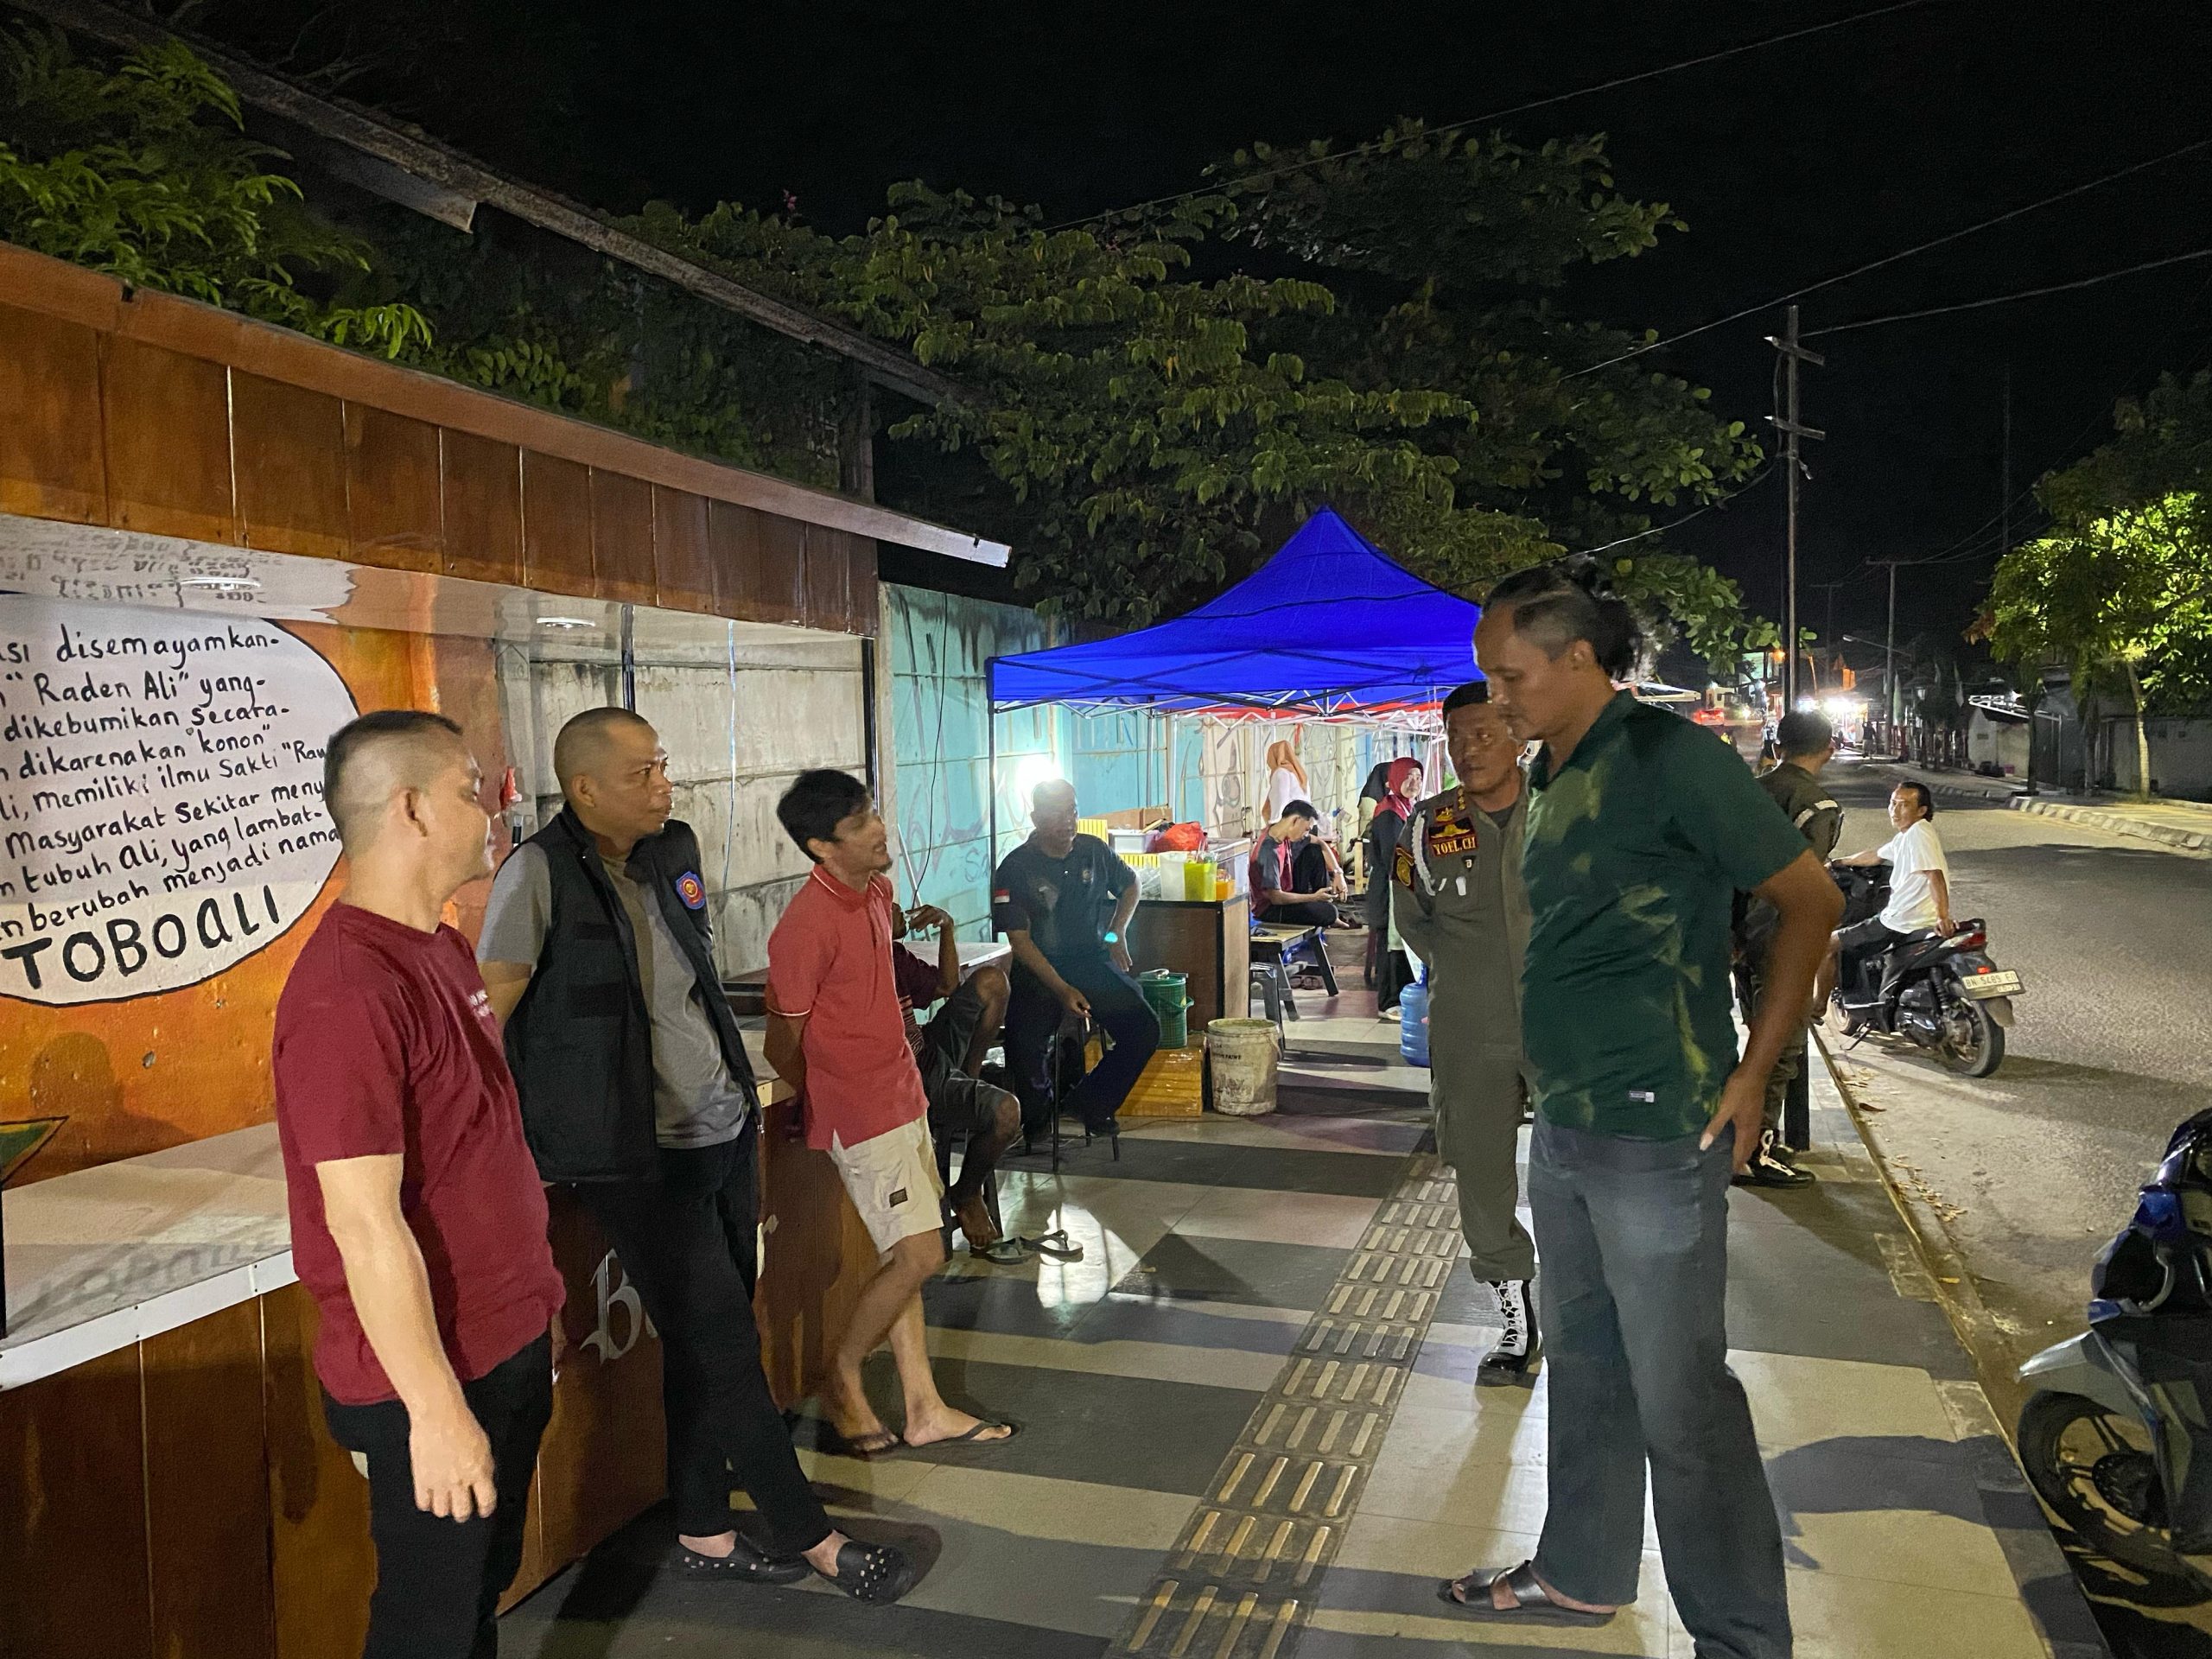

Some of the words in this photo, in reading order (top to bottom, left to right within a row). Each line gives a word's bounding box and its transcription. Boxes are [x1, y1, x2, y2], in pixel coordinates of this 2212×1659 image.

[0, 641, 30, 664] si
[3, 706, 181, 742] dikebumikan
[19, 739, 187, 779] dikarenakan
[157, 764, 211, 789] ilmu
[22, 852, 112, 893] tubuh
[171, 827, 231, 874] yang
[28, 880, 149, 932] berubah
[163, 842, 270, 893] menjadi
